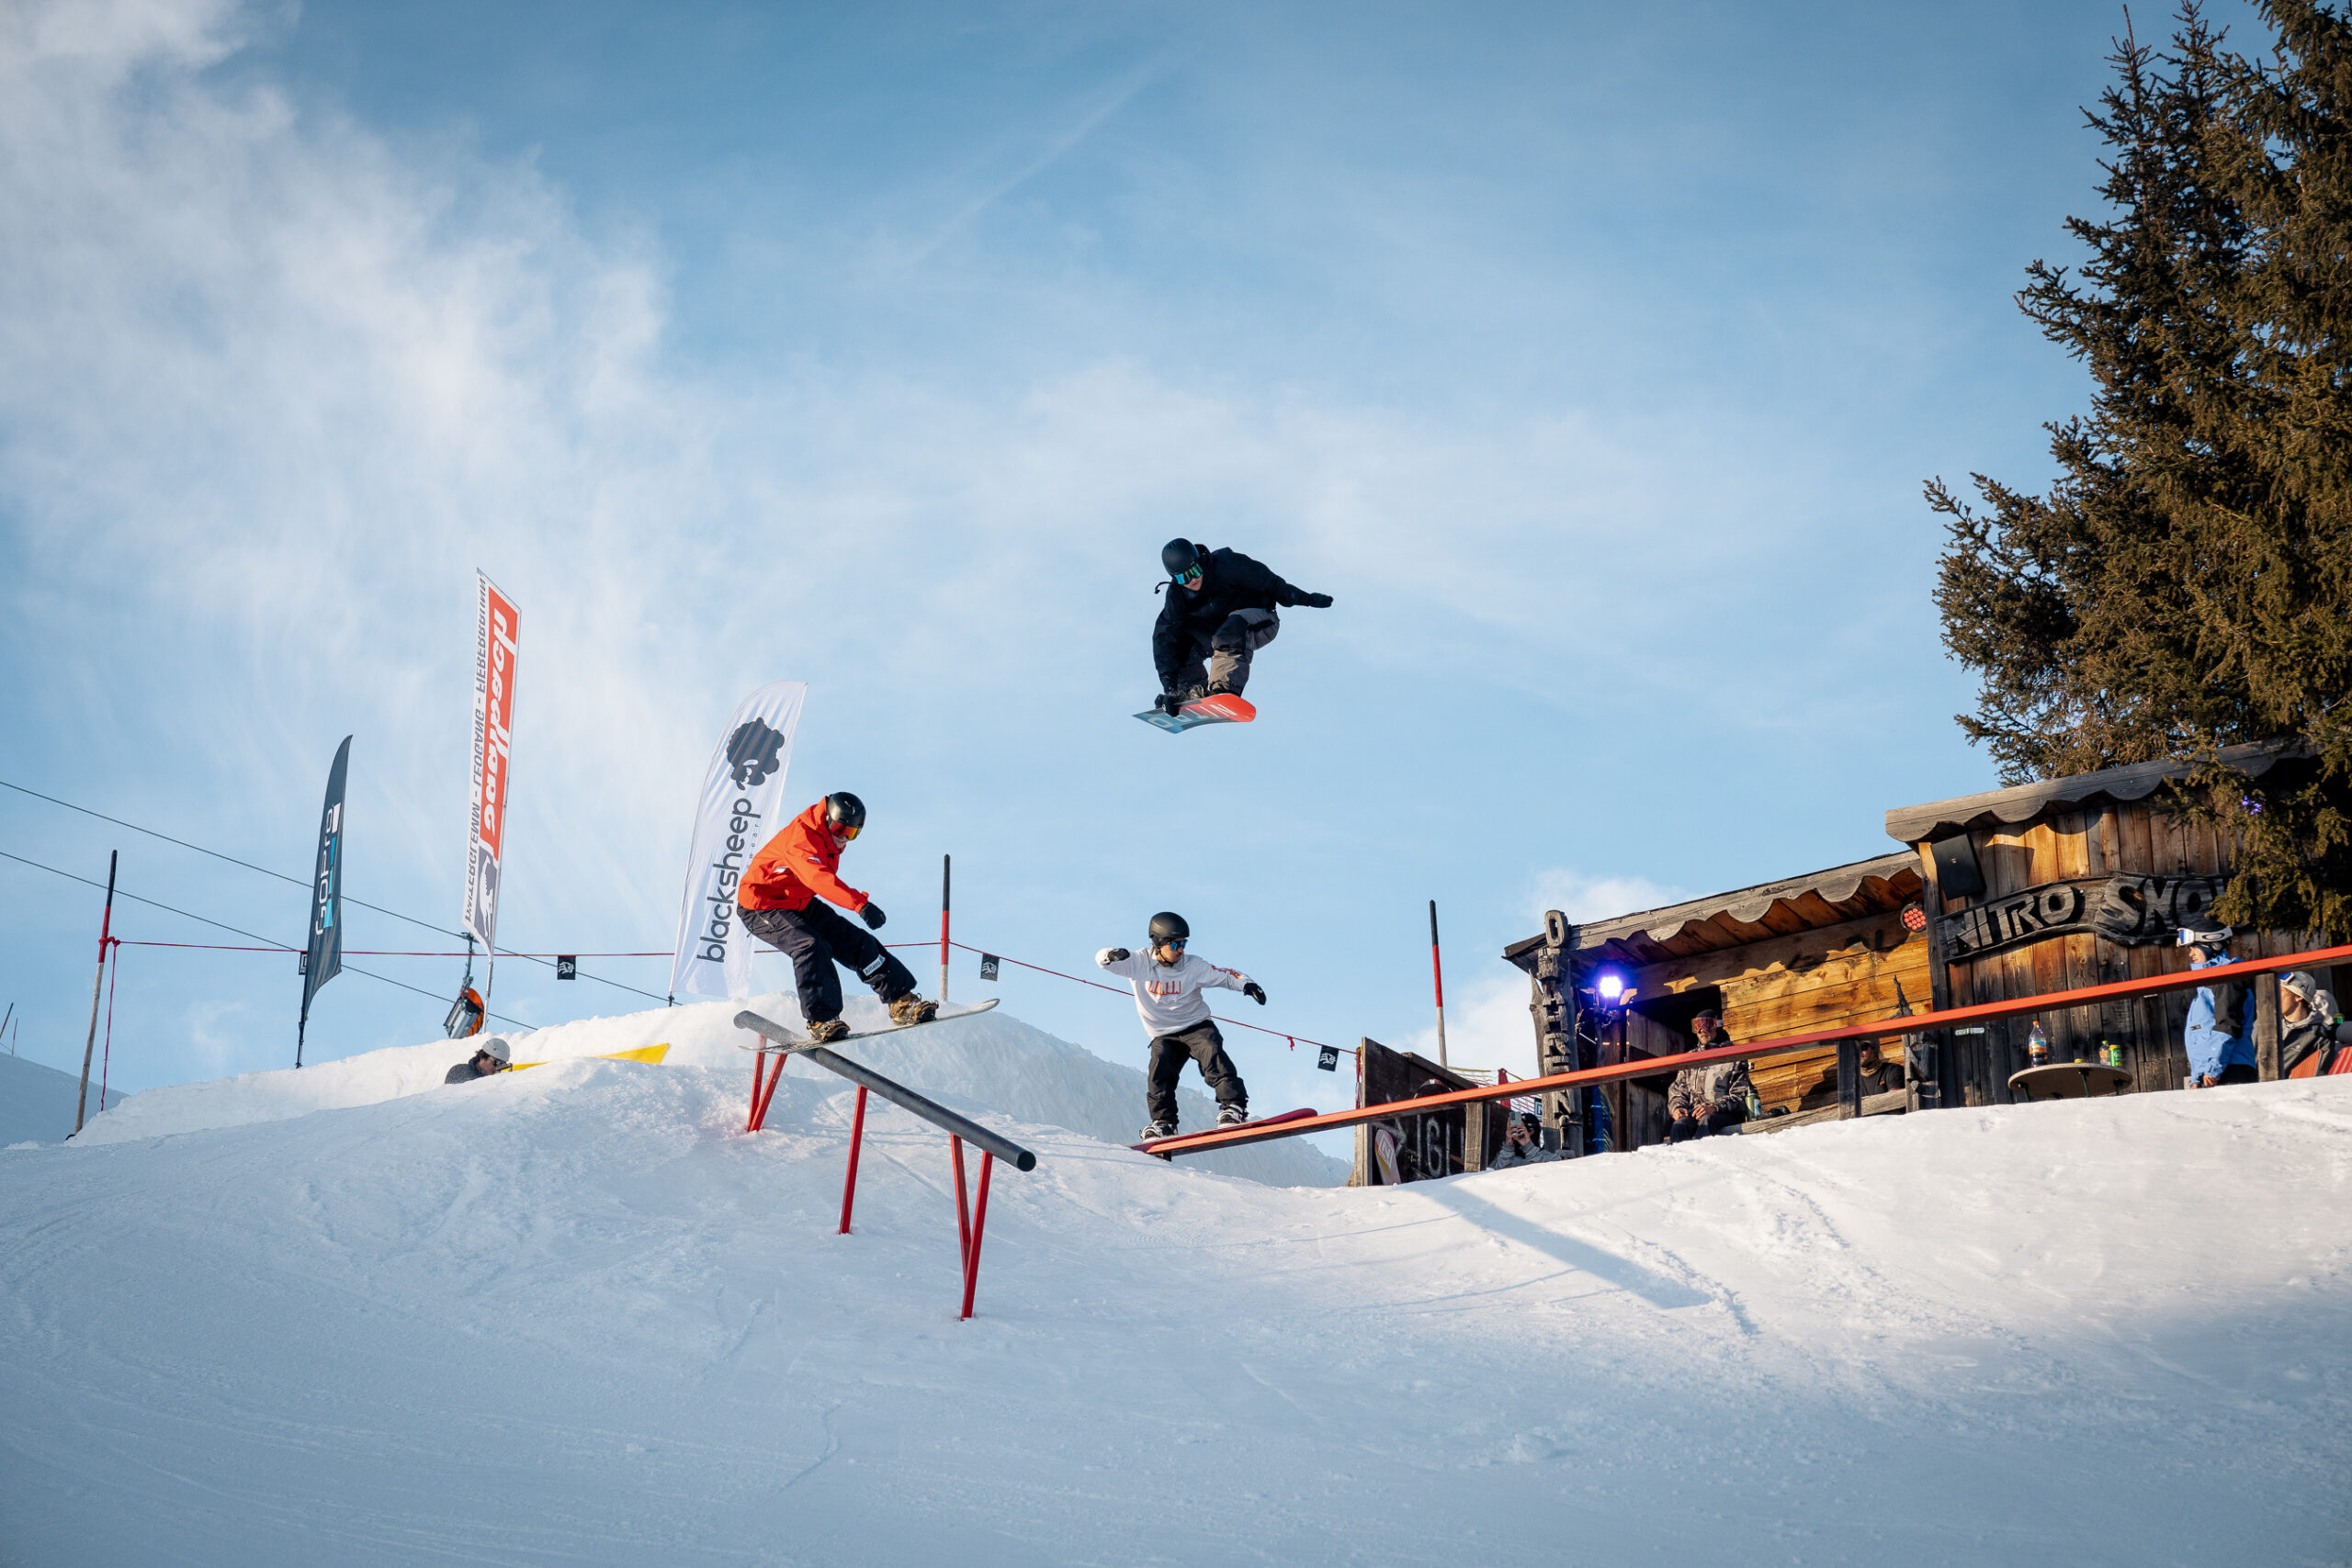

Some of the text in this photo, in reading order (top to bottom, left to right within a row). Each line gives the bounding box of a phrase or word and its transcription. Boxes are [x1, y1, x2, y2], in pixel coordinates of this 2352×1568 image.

[315, 807, 334, 935] GoPro
[696, 798, 762, 964] blacksheep
[749, 823, 760, 859] wear
[1943, 875, 2226, 955] NITRO SNO
